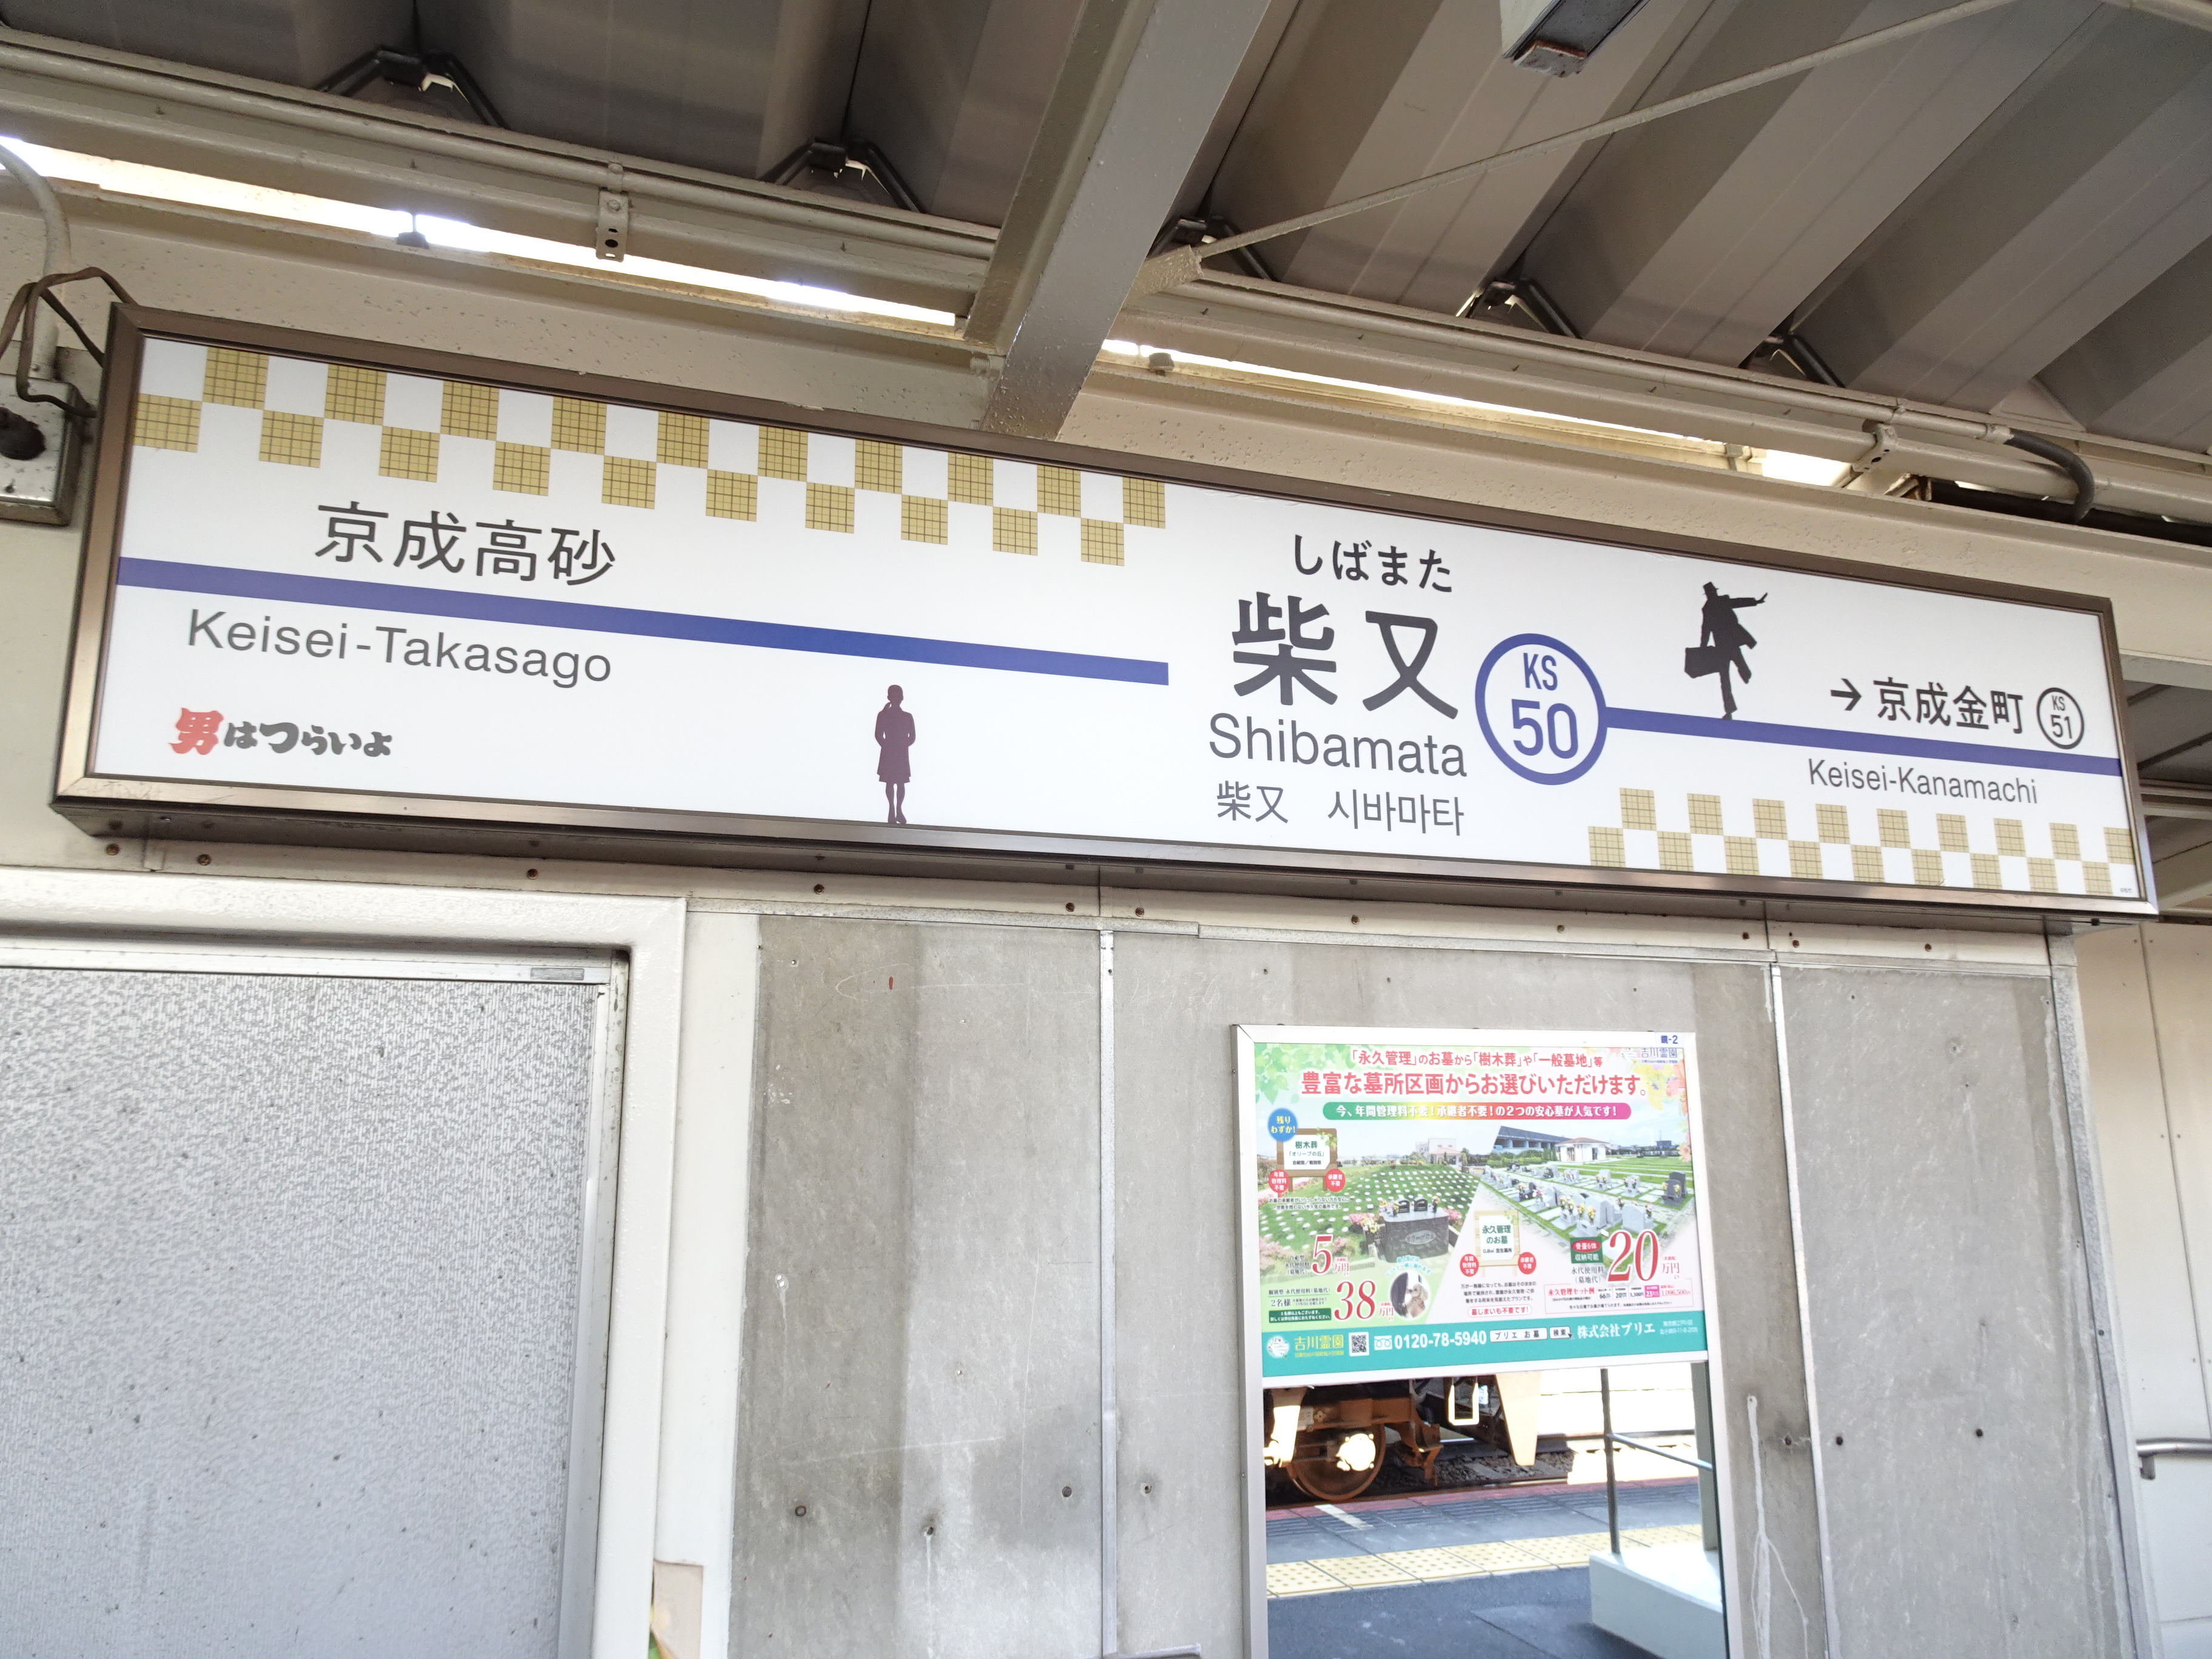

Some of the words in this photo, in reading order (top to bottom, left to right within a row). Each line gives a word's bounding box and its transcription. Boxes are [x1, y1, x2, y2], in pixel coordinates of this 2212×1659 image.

[315, 501, 616, 586] 京成高砂
[1294, 534, 1452, 593] しばまた
[189, 608, 612, 689] Keisei-Takasago
[1232, 591, 1459, 720] 柴又
[1522, 652, 1558, 691] KS
[1872, 676, 2024, 734] 京成金町
[2052, 695, 2066, 712] KS
[168, 707, 393, 757] 男はつらいよ
[1209, 712, 1467, 777] Shibamata
[1510, 699, 1578, 759] 50
[2051, 714, 2074, 740] 51
[1808, 758, 2038, 804] Keisei-Kanamachi
[1216, 780, 1289, 824] 柴又
[1327, 789, 1464, 836] 시바마타
[1301, 1071, 1646, 1096] 豊富な墓所区画からお選びいただけます。
[1276, 1115, 1291, 1124] 残り
[1295, 1141, 1318, 1149] 樹木葬
[1482, 1224, 1512, 1235] 永久管理
[1486, 1235, 1509, 1245] のお墓
[1333, 1263, 1350, 1272] 万円
[1607, 1230, 1659, 1282] 20
[1661, 1262, 1680, 1275] 万円
[1271, 1298, 1291, 1307] 2名様
[1334, 1280, 1376, 1321] 38
[1379, 1307, 1395, 1316] 万円
[1294, 1334, 1344, 1351] 吉川霊園
[1395, 1330, 1487, 1350] 0120-78-5940
